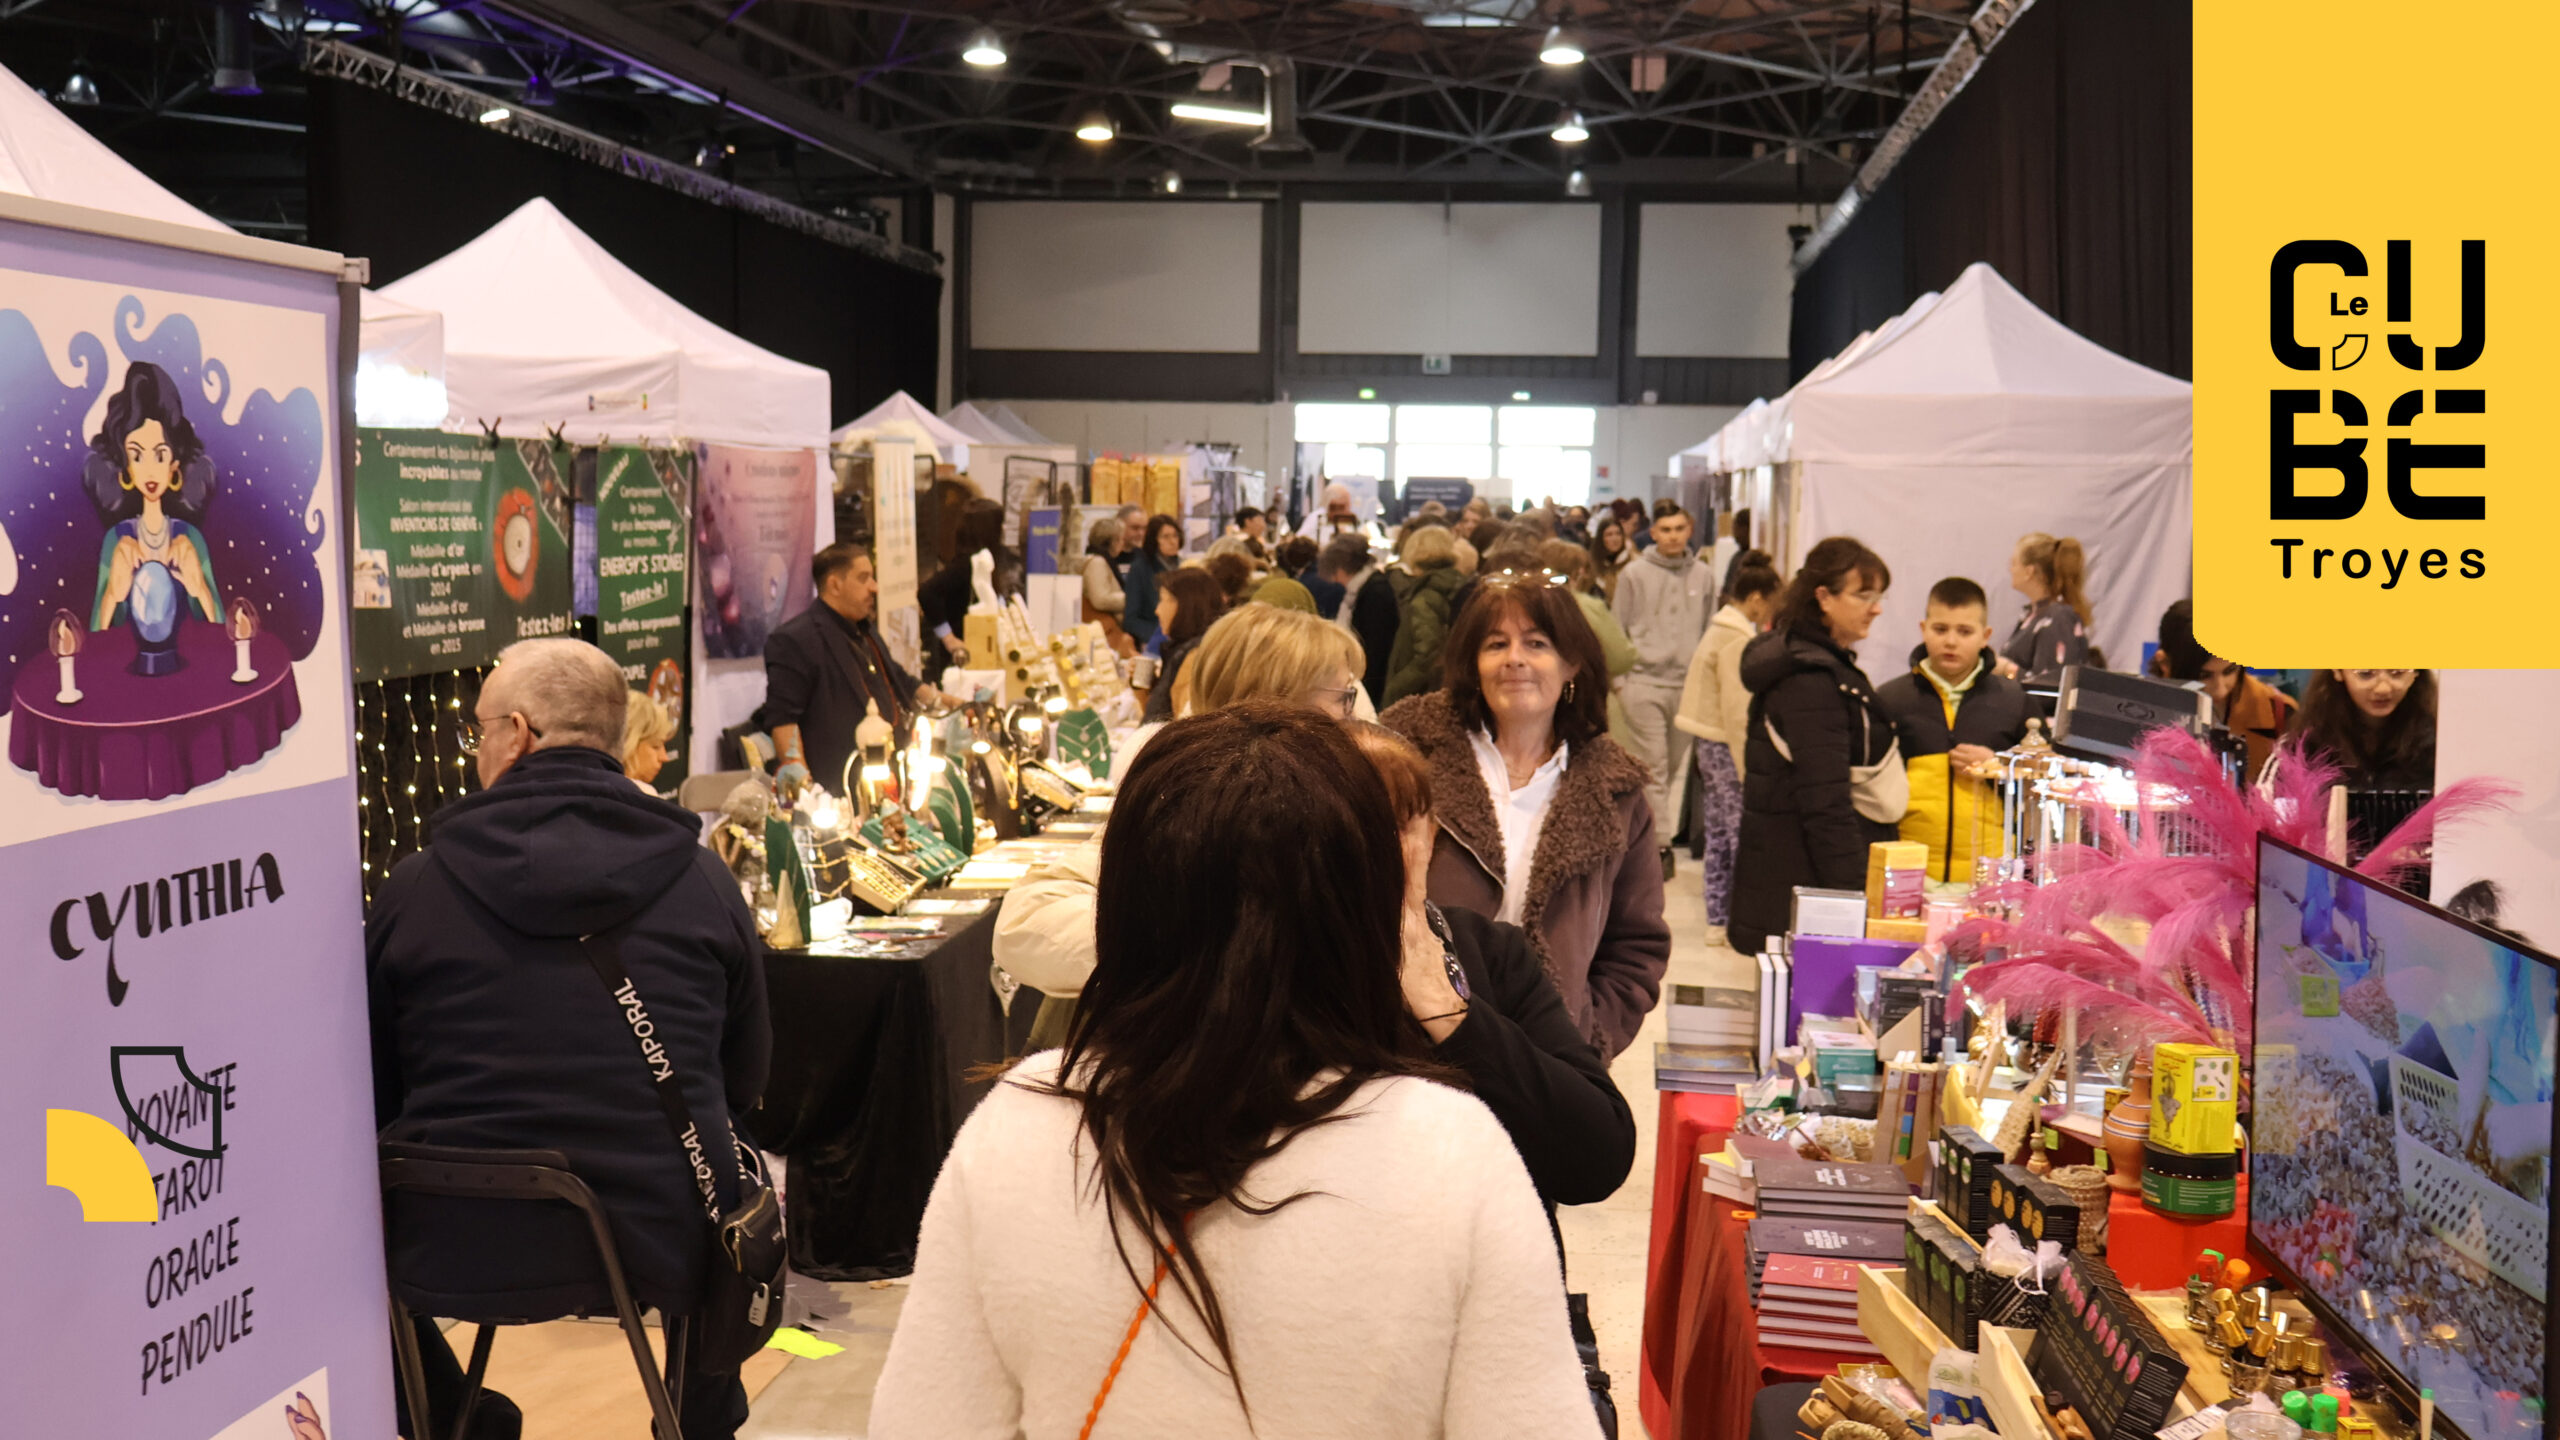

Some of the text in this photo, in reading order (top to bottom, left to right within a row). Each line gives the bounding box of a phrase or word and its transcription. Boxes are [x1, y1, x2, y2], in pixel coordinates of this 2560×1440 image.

[390, 516, 438, 533] INVENTIONS
[439, 516, 450, 532] DE
[600, 553, 684, 577] ENERGY'S STONES
[50, 852, 285, 1007] CYNTHIA
[614, 977, 674, 1082] KAPORAL
[145, 1216, 240, 1309] ORACLE
[142, 1287, 254, 1396] PENDULE
